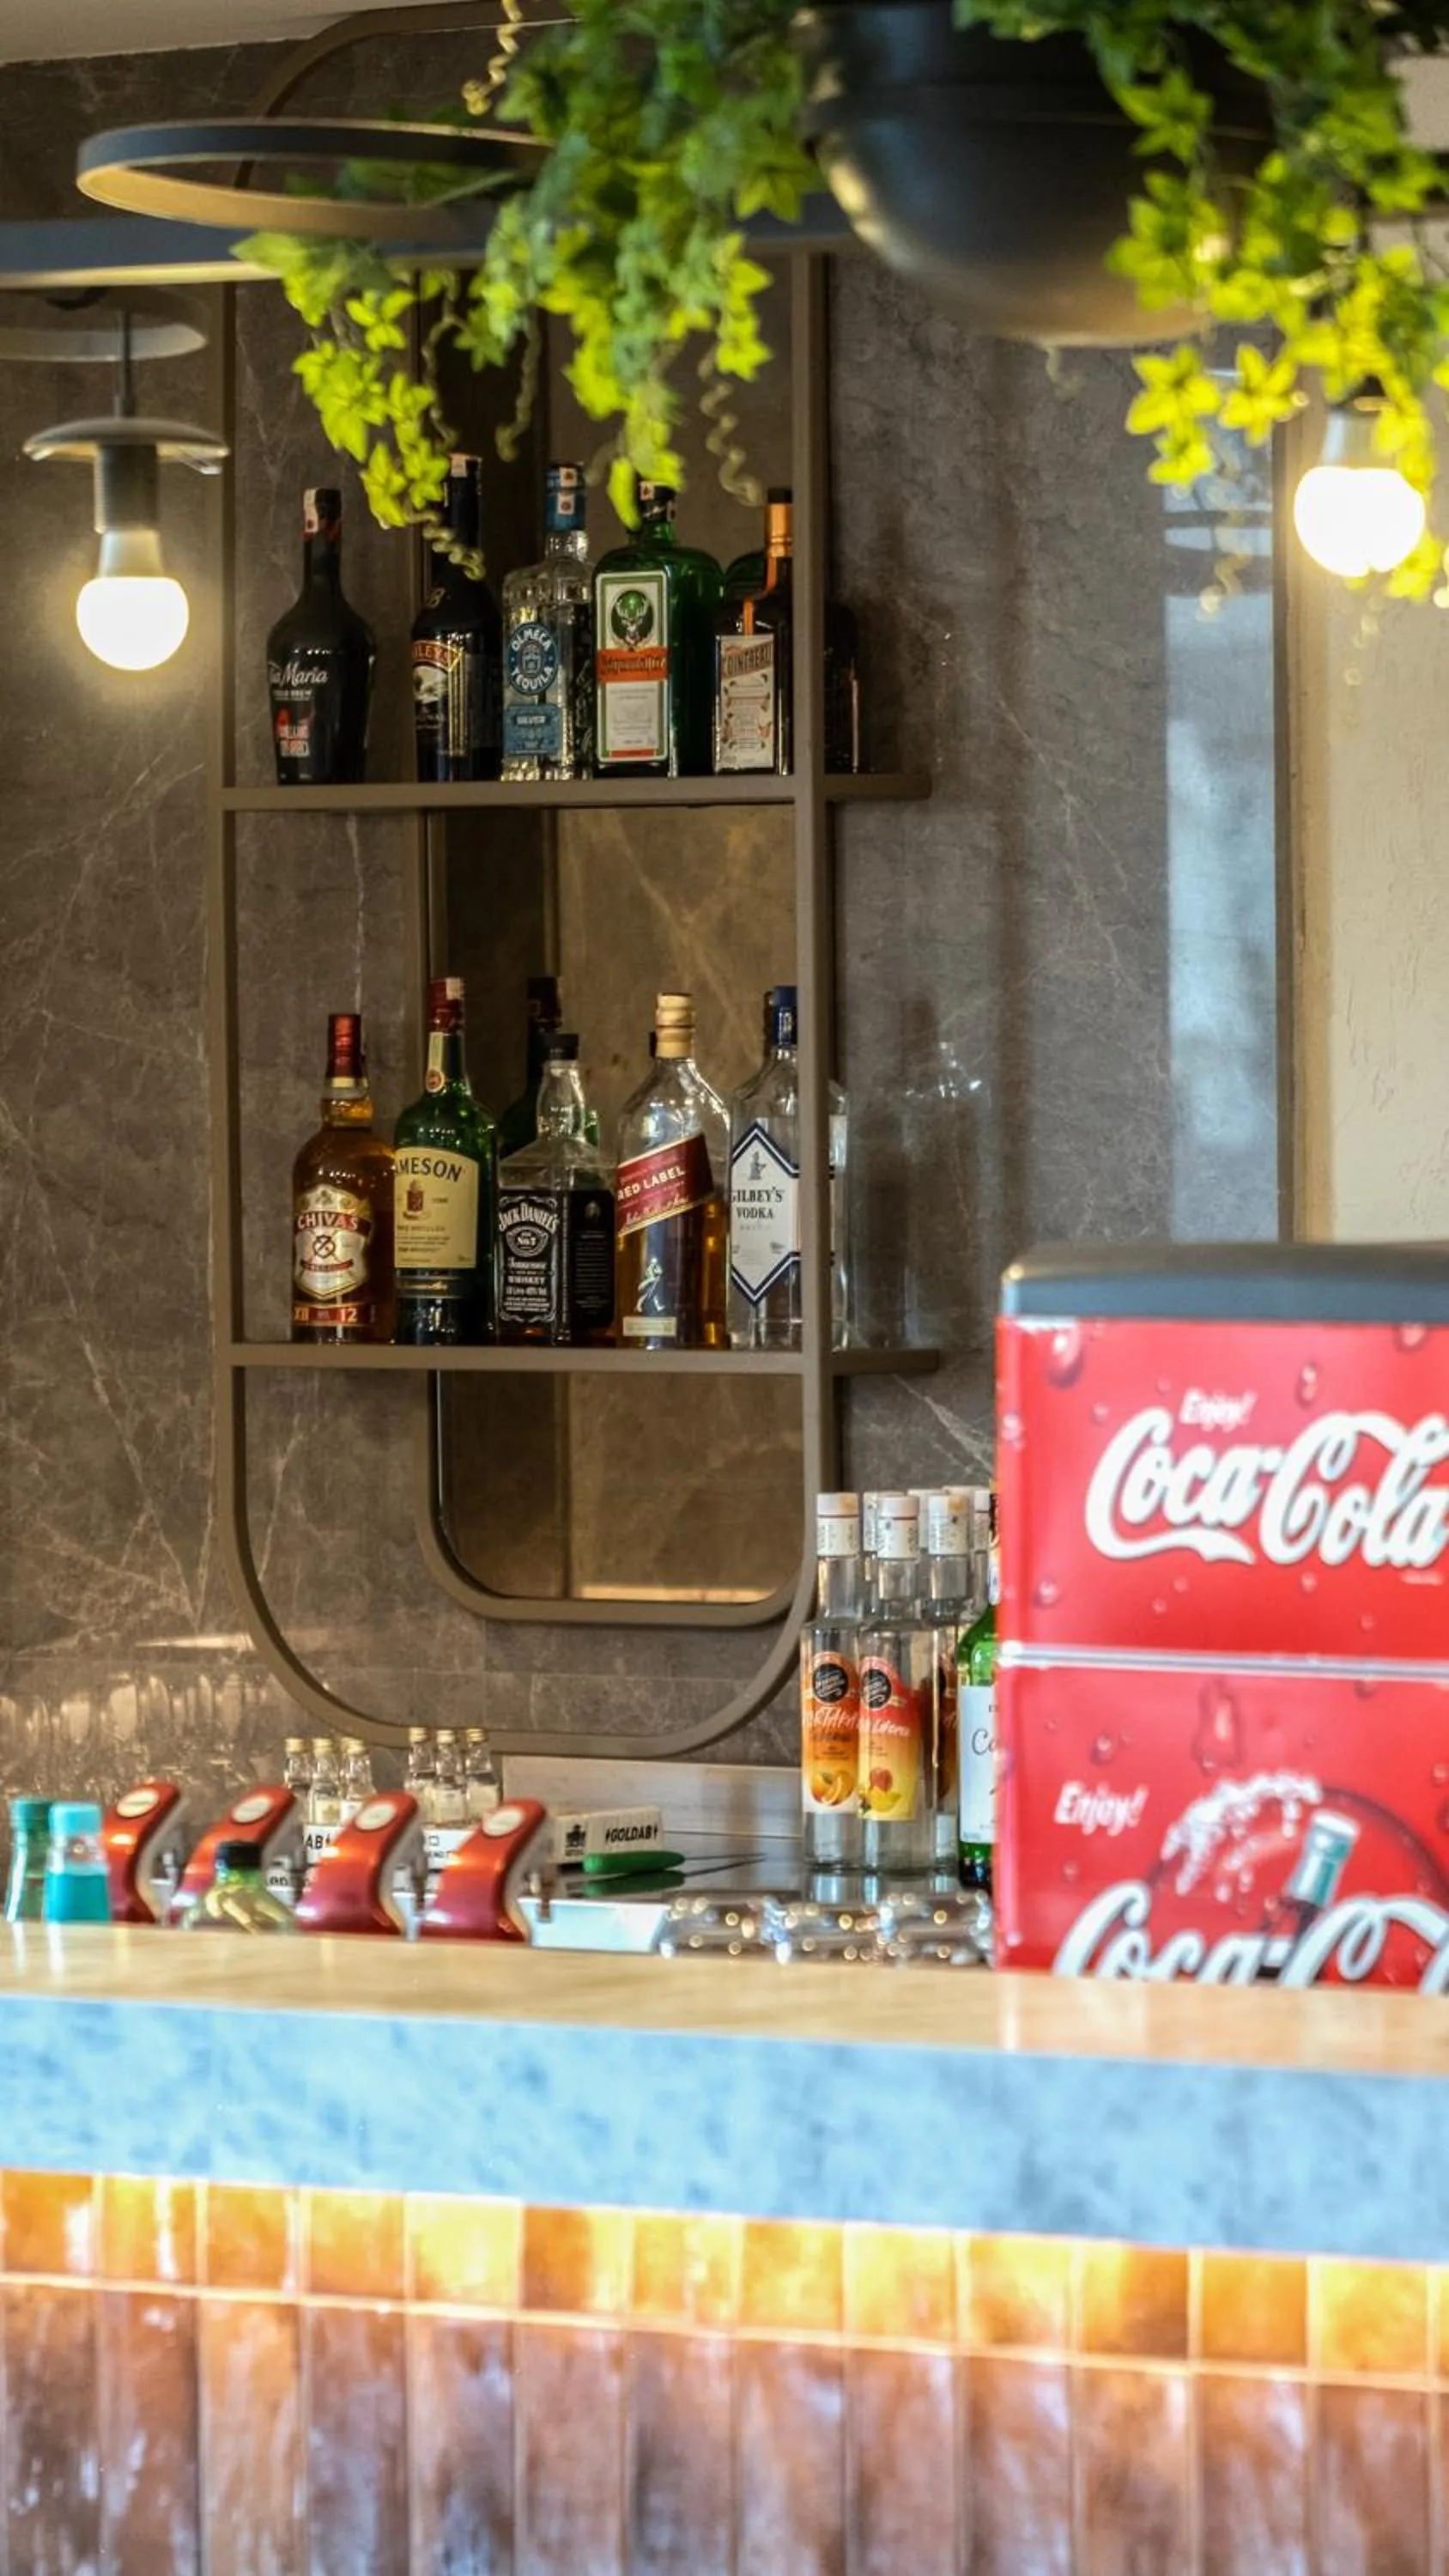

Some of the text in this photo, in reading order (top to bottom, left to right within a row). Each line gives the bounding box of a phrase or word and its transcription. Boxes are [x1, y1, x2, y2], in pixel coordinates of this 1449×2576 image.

[511, 629, 552, 652] OLMECA
[281, 660, 329, 687] Maria
[511, 666, 554, 690] TEQUILA
[643, 1165, 687, 1190] LABEL
[297, 1212, 358, 1230] CHIVAS
[499, 1207, 520, 1232] JACK
[737, 1207, 774, 1219] VODKA
[340, 1308, 358, 1322] 12
[1179, 1387, 1258, 1432] Enjoy!
[1053, 1780, 1149, 1837] Enjoy!
